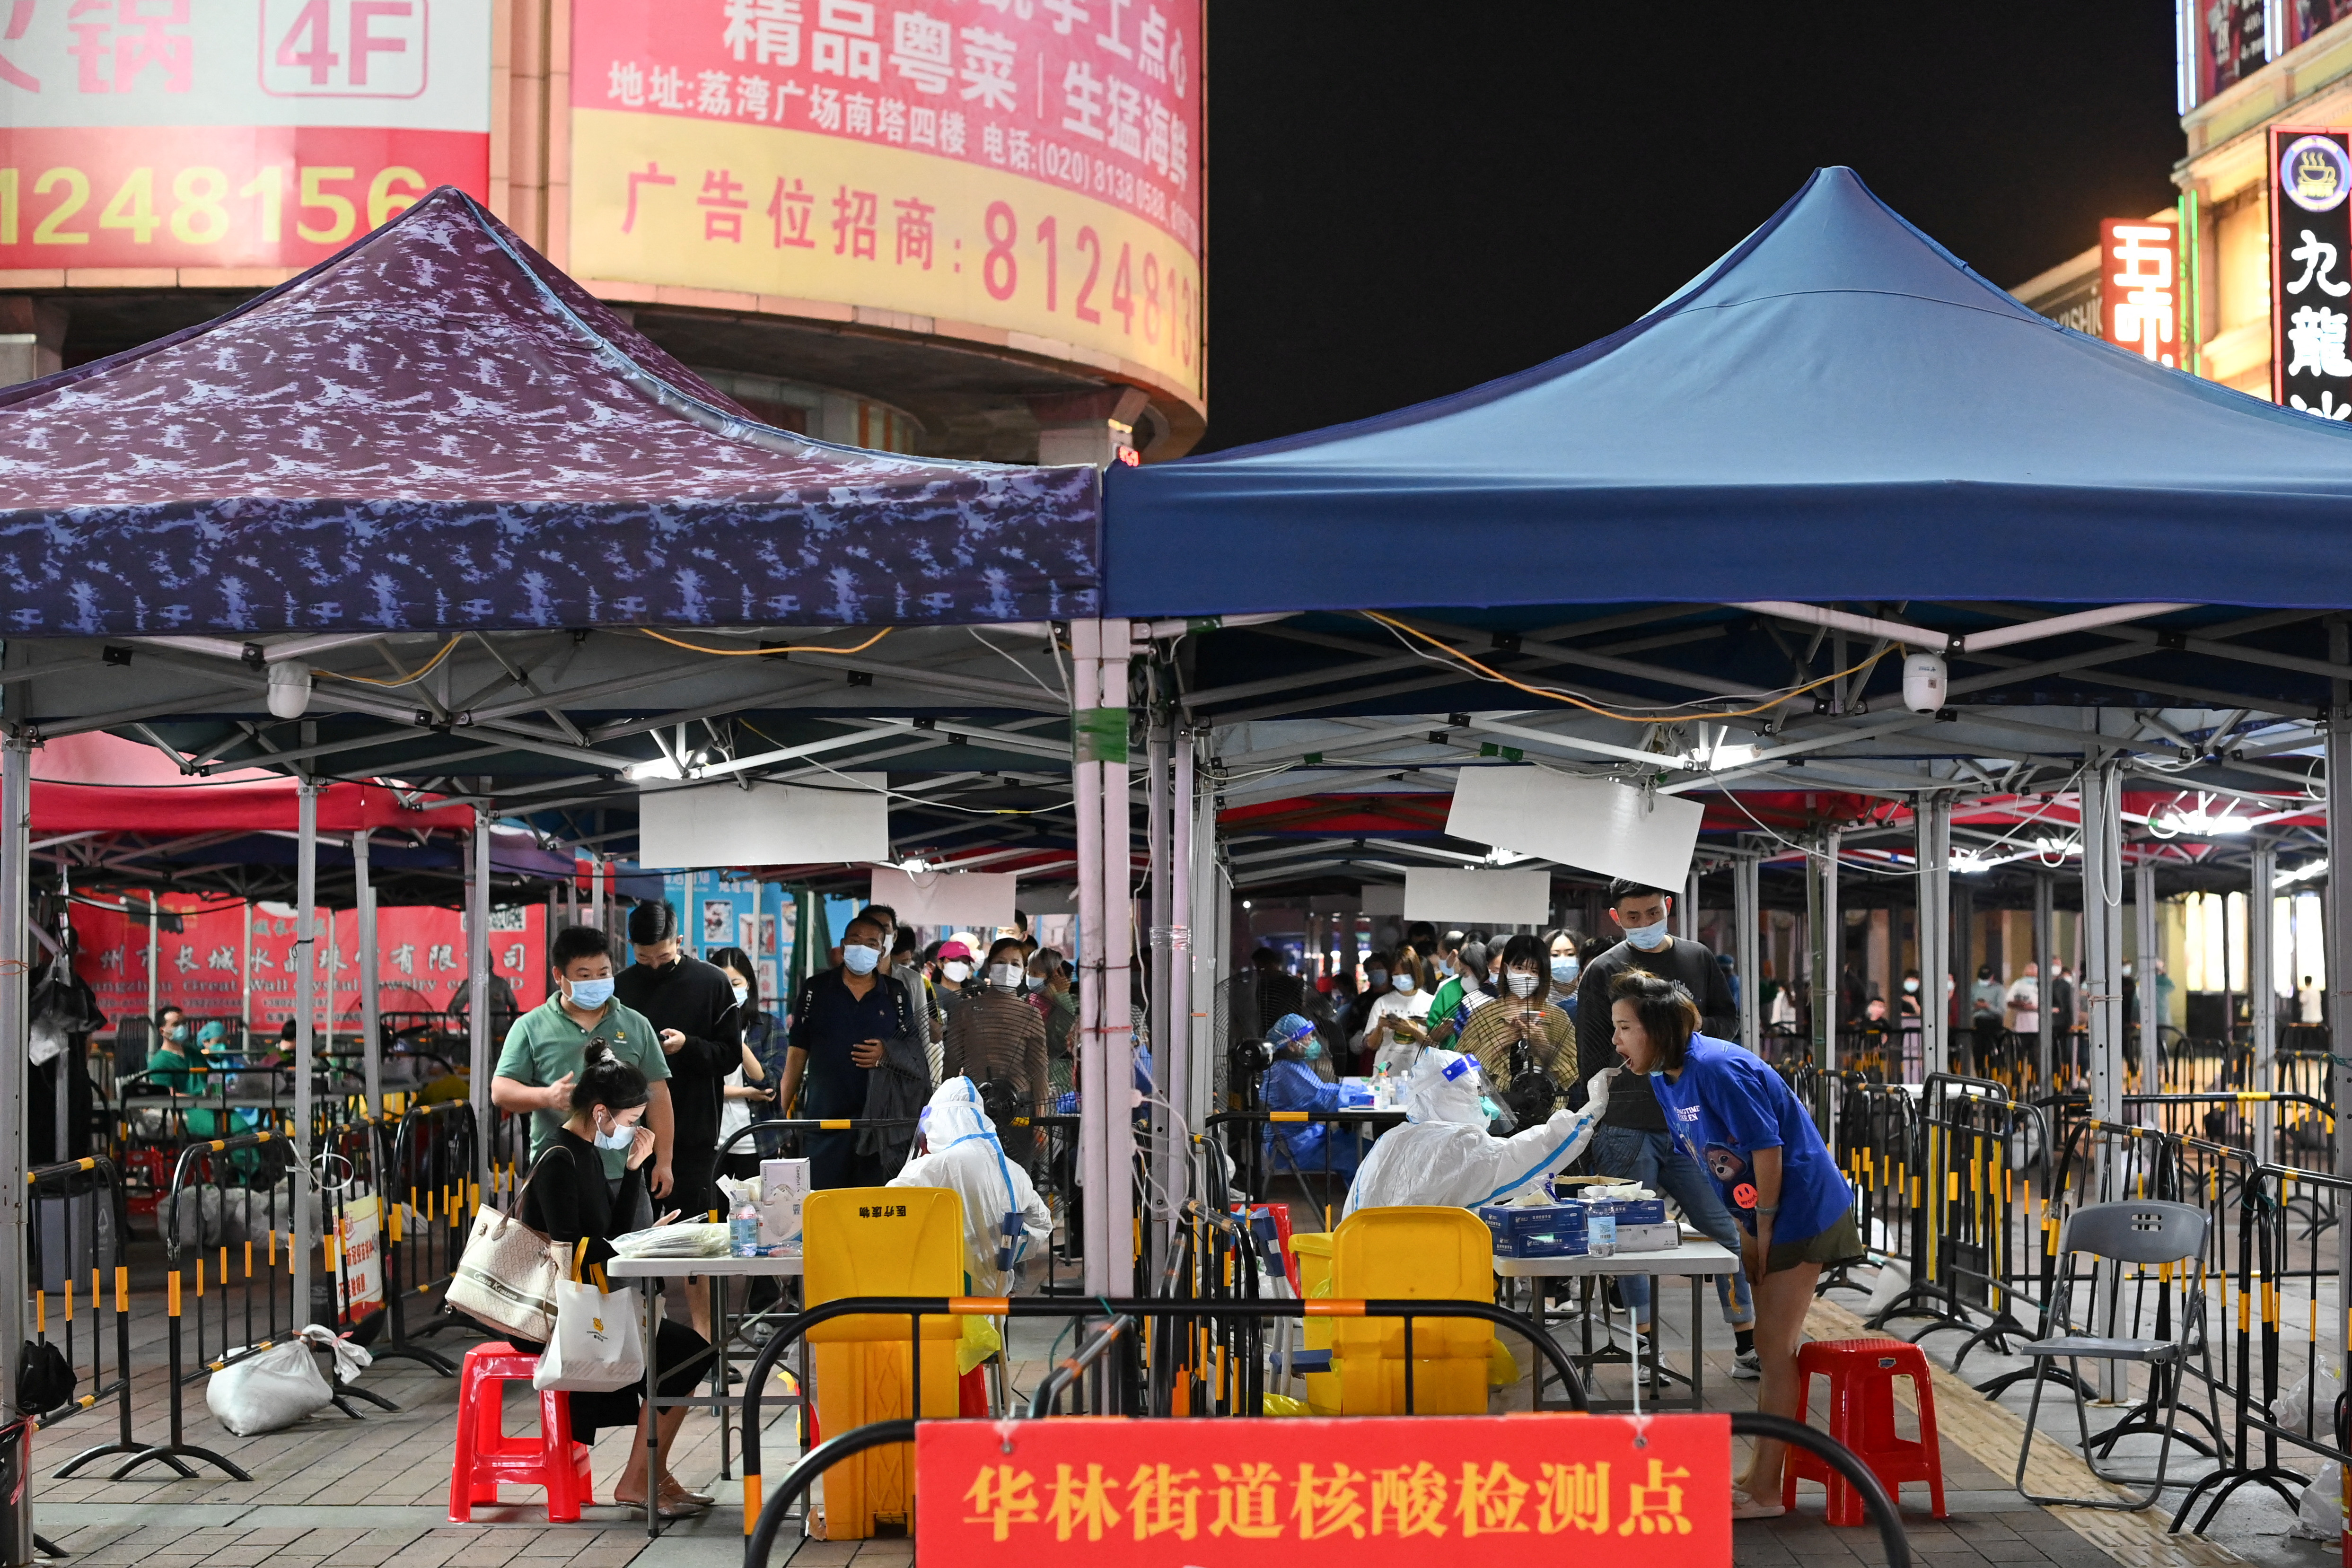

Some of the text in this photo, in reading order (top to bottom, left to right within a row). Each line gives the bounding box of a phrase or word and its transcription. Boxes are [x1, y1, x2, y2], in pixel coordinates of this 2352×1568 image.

[275, 0, 414, 87] 4F
[723, 0, 1018, 113] 精品粤菜
[978, 0, 1187, 99] 工点心
[78, 943, 527, 975] 州市长城水珠有限司
[859, 1205, 906, 1218] 医疗废物
[492, 1281, 518, 1300] Krause
[963, 1459, 1692, 1542] 华林街道核酸检测点
